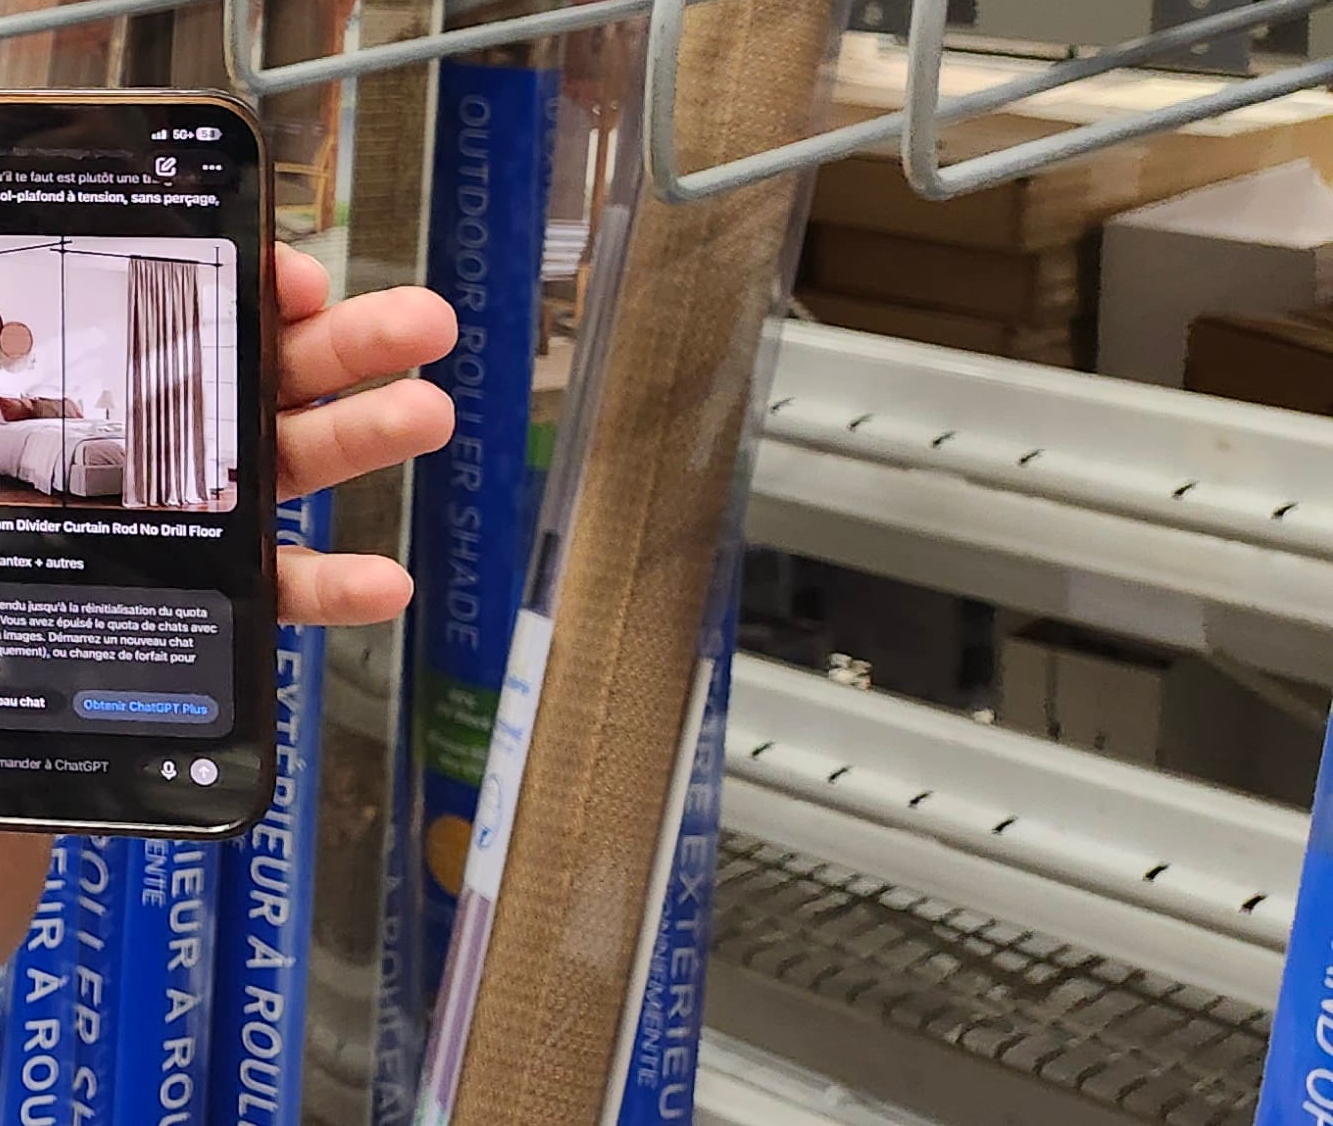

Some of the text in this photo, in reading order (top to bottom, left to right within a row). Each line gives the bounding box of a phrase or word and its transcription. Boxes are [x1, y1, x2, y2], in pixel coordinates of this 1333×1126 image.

[30, 170, 54, 183] faut
[56, 172, 76, 184] est
[78, 172, 114, 186] plutôt
[116, 174, 140, 184] une
[66, 190, 75, 202] à
[77, 190, 129, 206] tension,
[131, 193, 161, 204] sans
[163, 194, 221, 207] perçage,
[455, 93, 492, 313] OUTDOOR
[450, 328, 487, 493] ROLLER
[16, 519, 61, 533] Divider
[63, 521, 110, 534] Curtain
[112, 522, 138, 535] Rod
[140, 523, 159, 536] No
[161, 524, 187, 537] Drill
[189, 525, 223, 538] Floor
[45, 558, 85, 571] autres
[444, 506, 483, 652] SHADE
[69, 602, 79, 613] la
[158, 605, 173, 617] du
[175, 607, 209, 619] quota
[0, 615, 27, 627] Vous
[29, 618, 55, 628] avez
[107, 620, 139, 632] quota
[141, 620, 156, 632] de
[158, 621, 189, 633] chats
[190, 624, 219, 634] avec
[3, 630, 46, 643] images.
[48, 631, 101, 644] Démarrez
[103, 635, 118, 645] un
[120, 636, 167, 647] nouveau
[168, 636, 194, 648] chat
[53, 648, 68, 659] ou
[69, 647, 115, 661] changez
[118, 650, 133, 661] de
[134, 650, 168, 662] forfait
[170, 653, 197, 665] pour
[19, 695, 46, 709] chat
[128, 700, 180, 714] ChatGPT
[182, 702, 209, 716] Plus
[44, 758, 52, 771] à
[54, 758, 109, 773] ChatGPT
[237, 984, 284, 1126] ROUL
